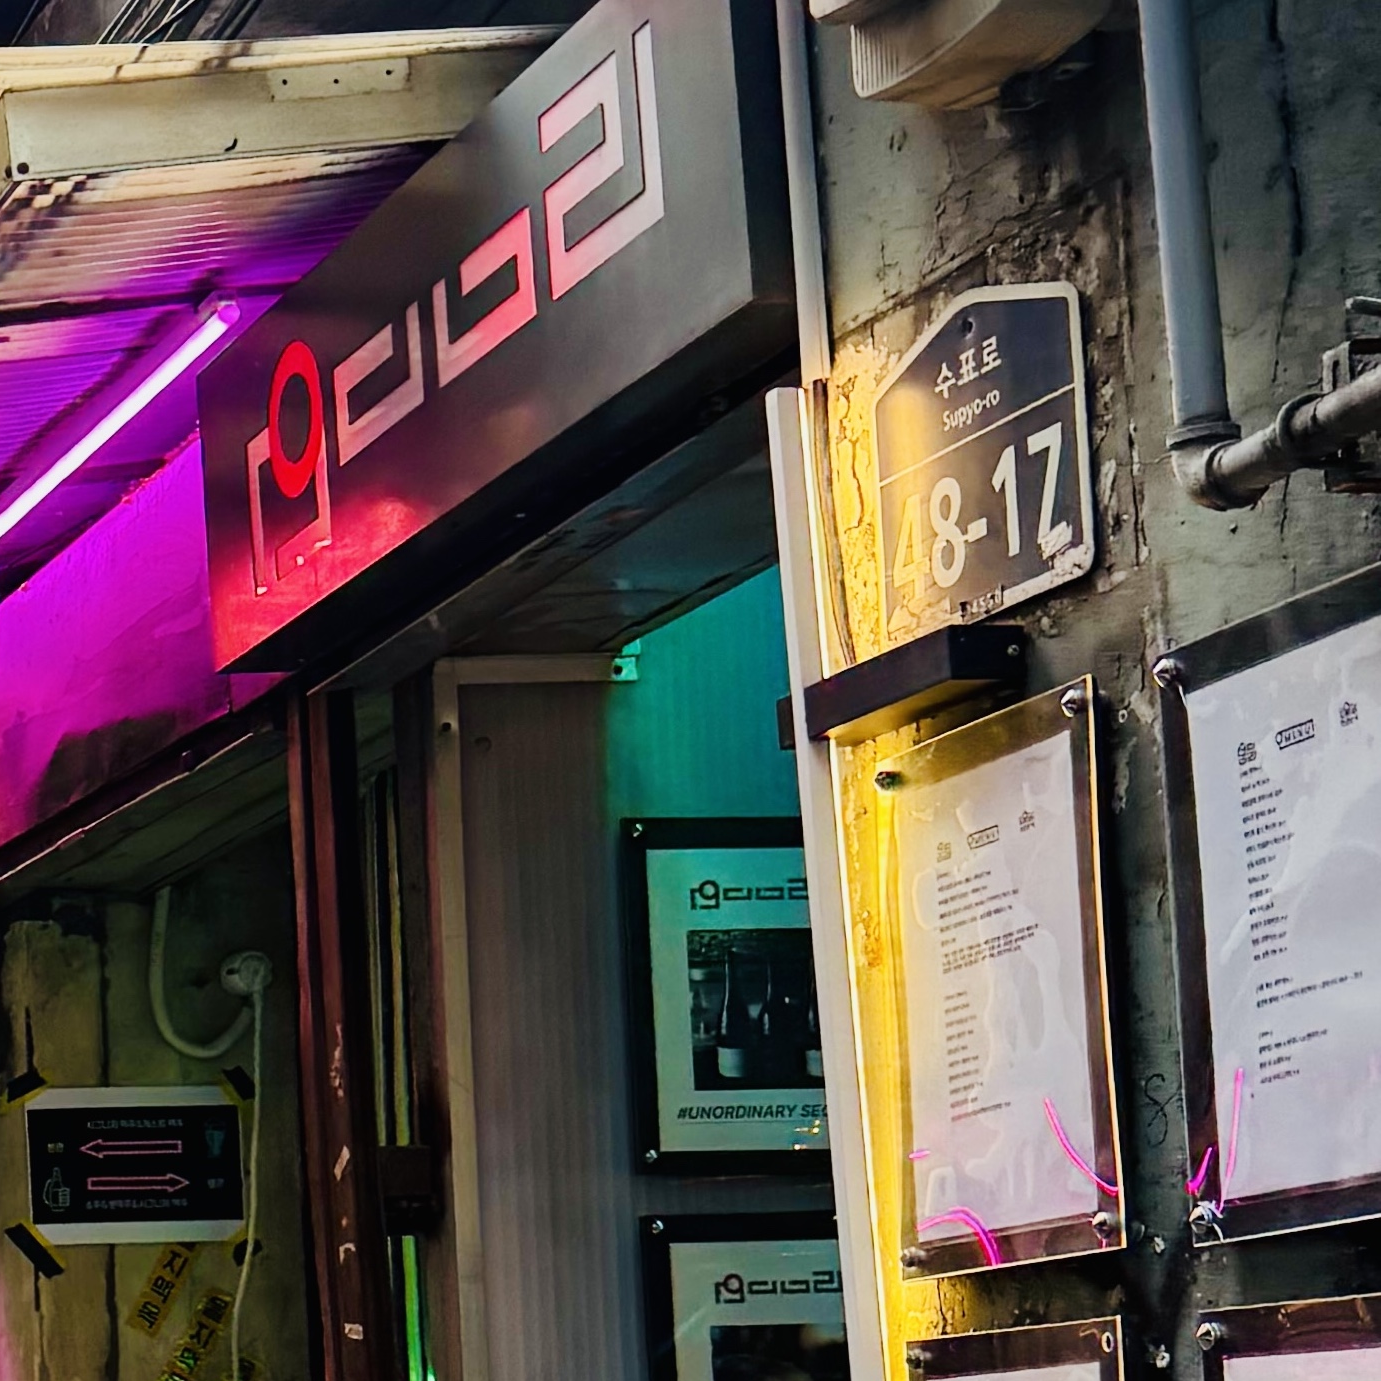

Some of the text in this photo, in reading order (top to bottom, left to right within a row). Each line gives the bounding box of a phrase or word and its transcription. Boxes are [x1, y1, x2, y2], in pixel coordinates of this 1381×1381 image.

[934, 336, 1002, 399] 수표로
[943, 390, 1001, 431] Supyo-ro
[677, 1102, 797, 1122] #UNORDINARY
